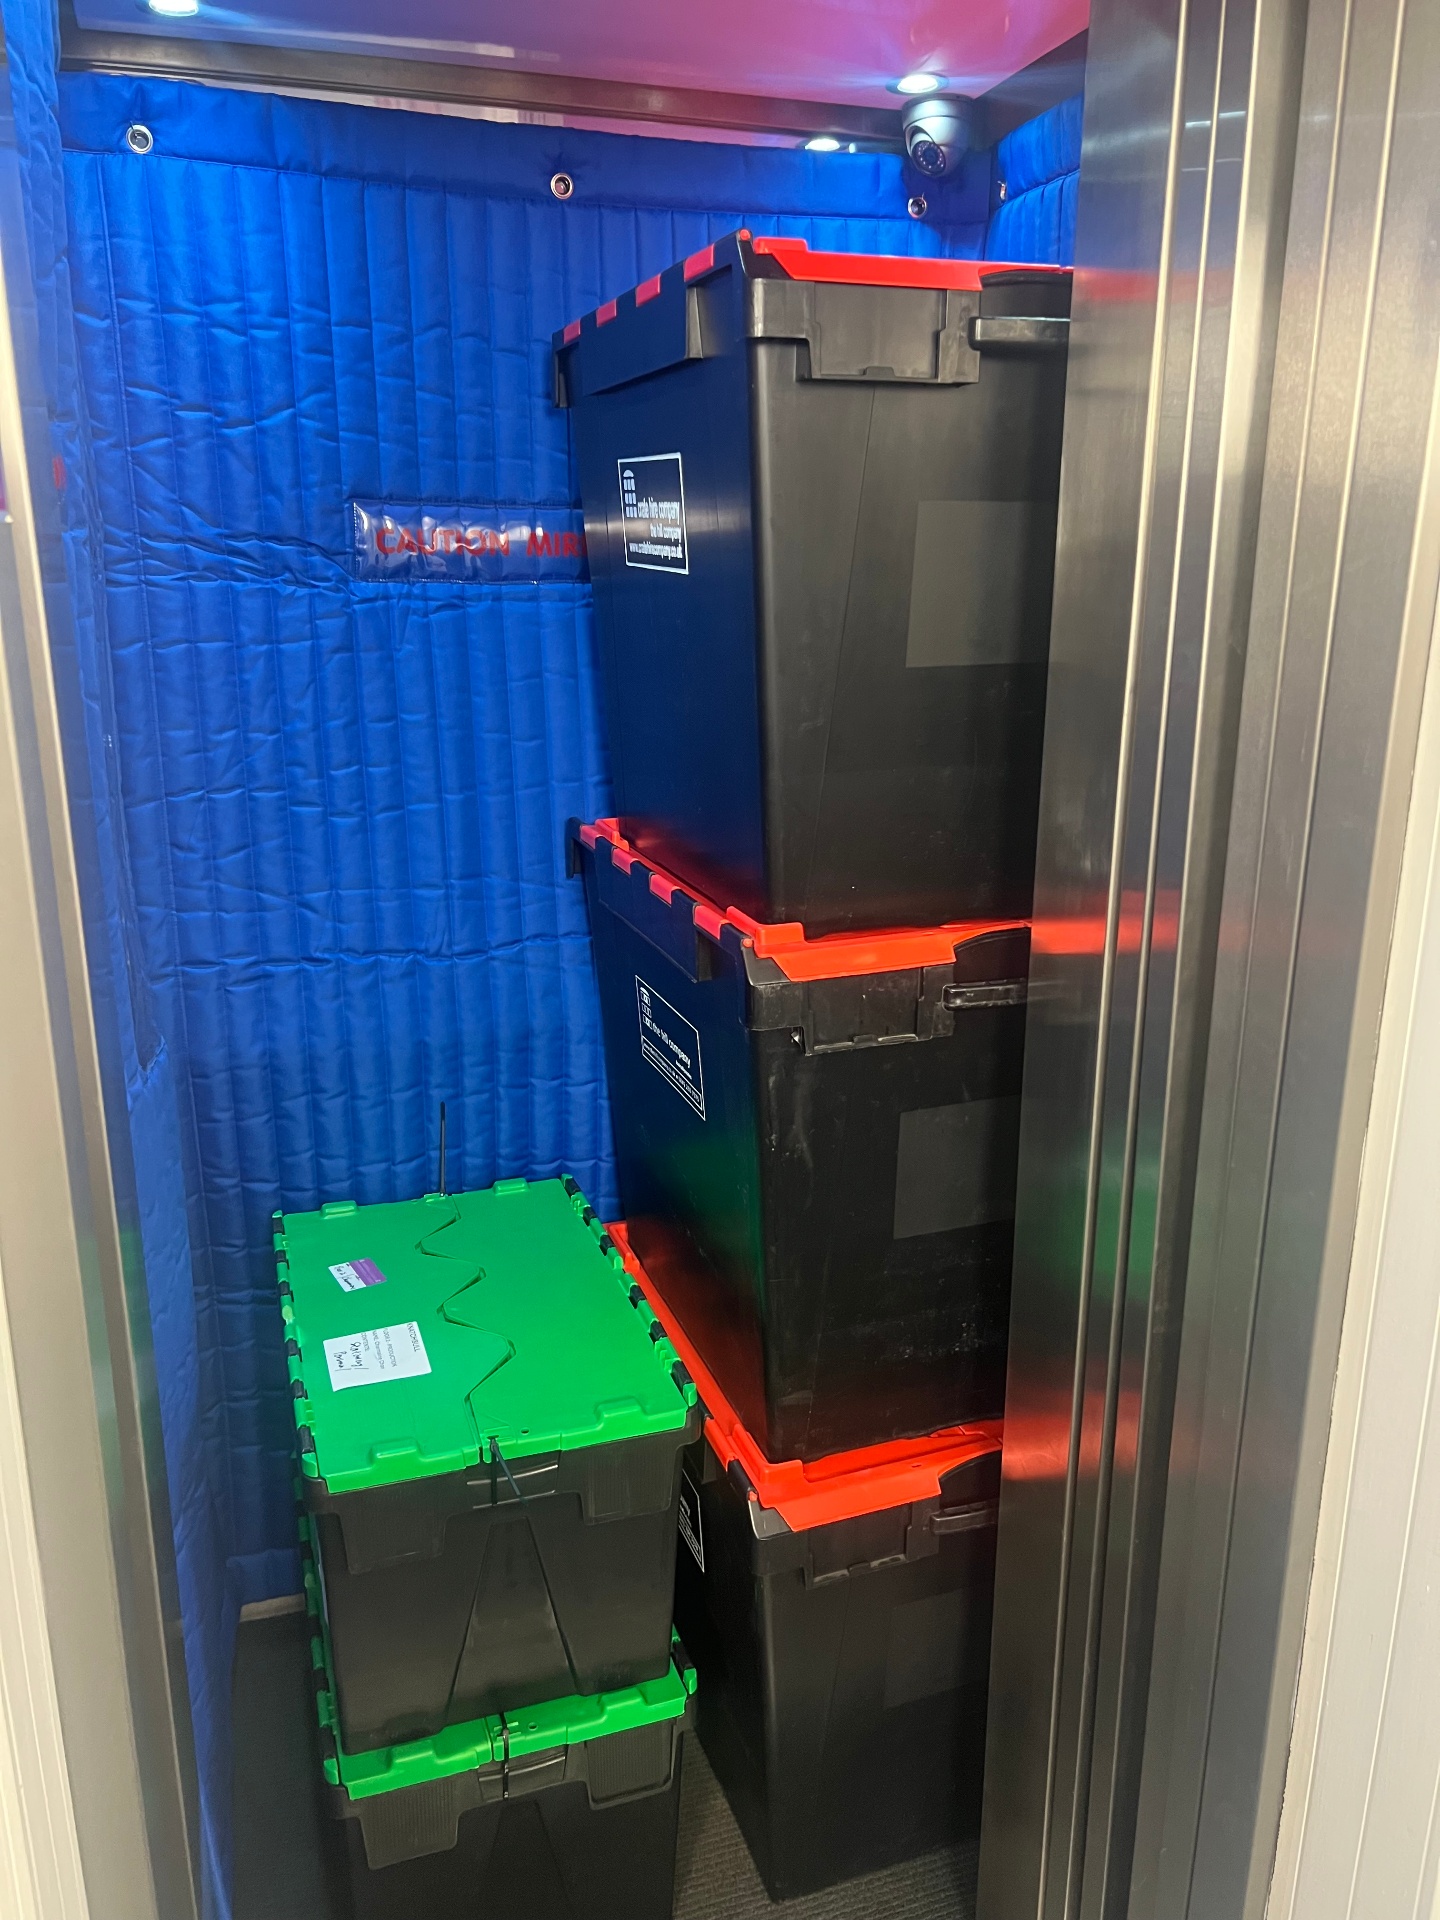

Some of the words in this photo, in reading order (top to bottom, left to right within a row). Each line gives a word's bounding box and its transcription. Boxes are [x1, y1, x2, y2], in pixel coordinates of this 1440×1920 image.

[659, 501, 680, 525] company
[376, 527, 510, 557] CAUTION
[668, 1039, 691, 1069] company
